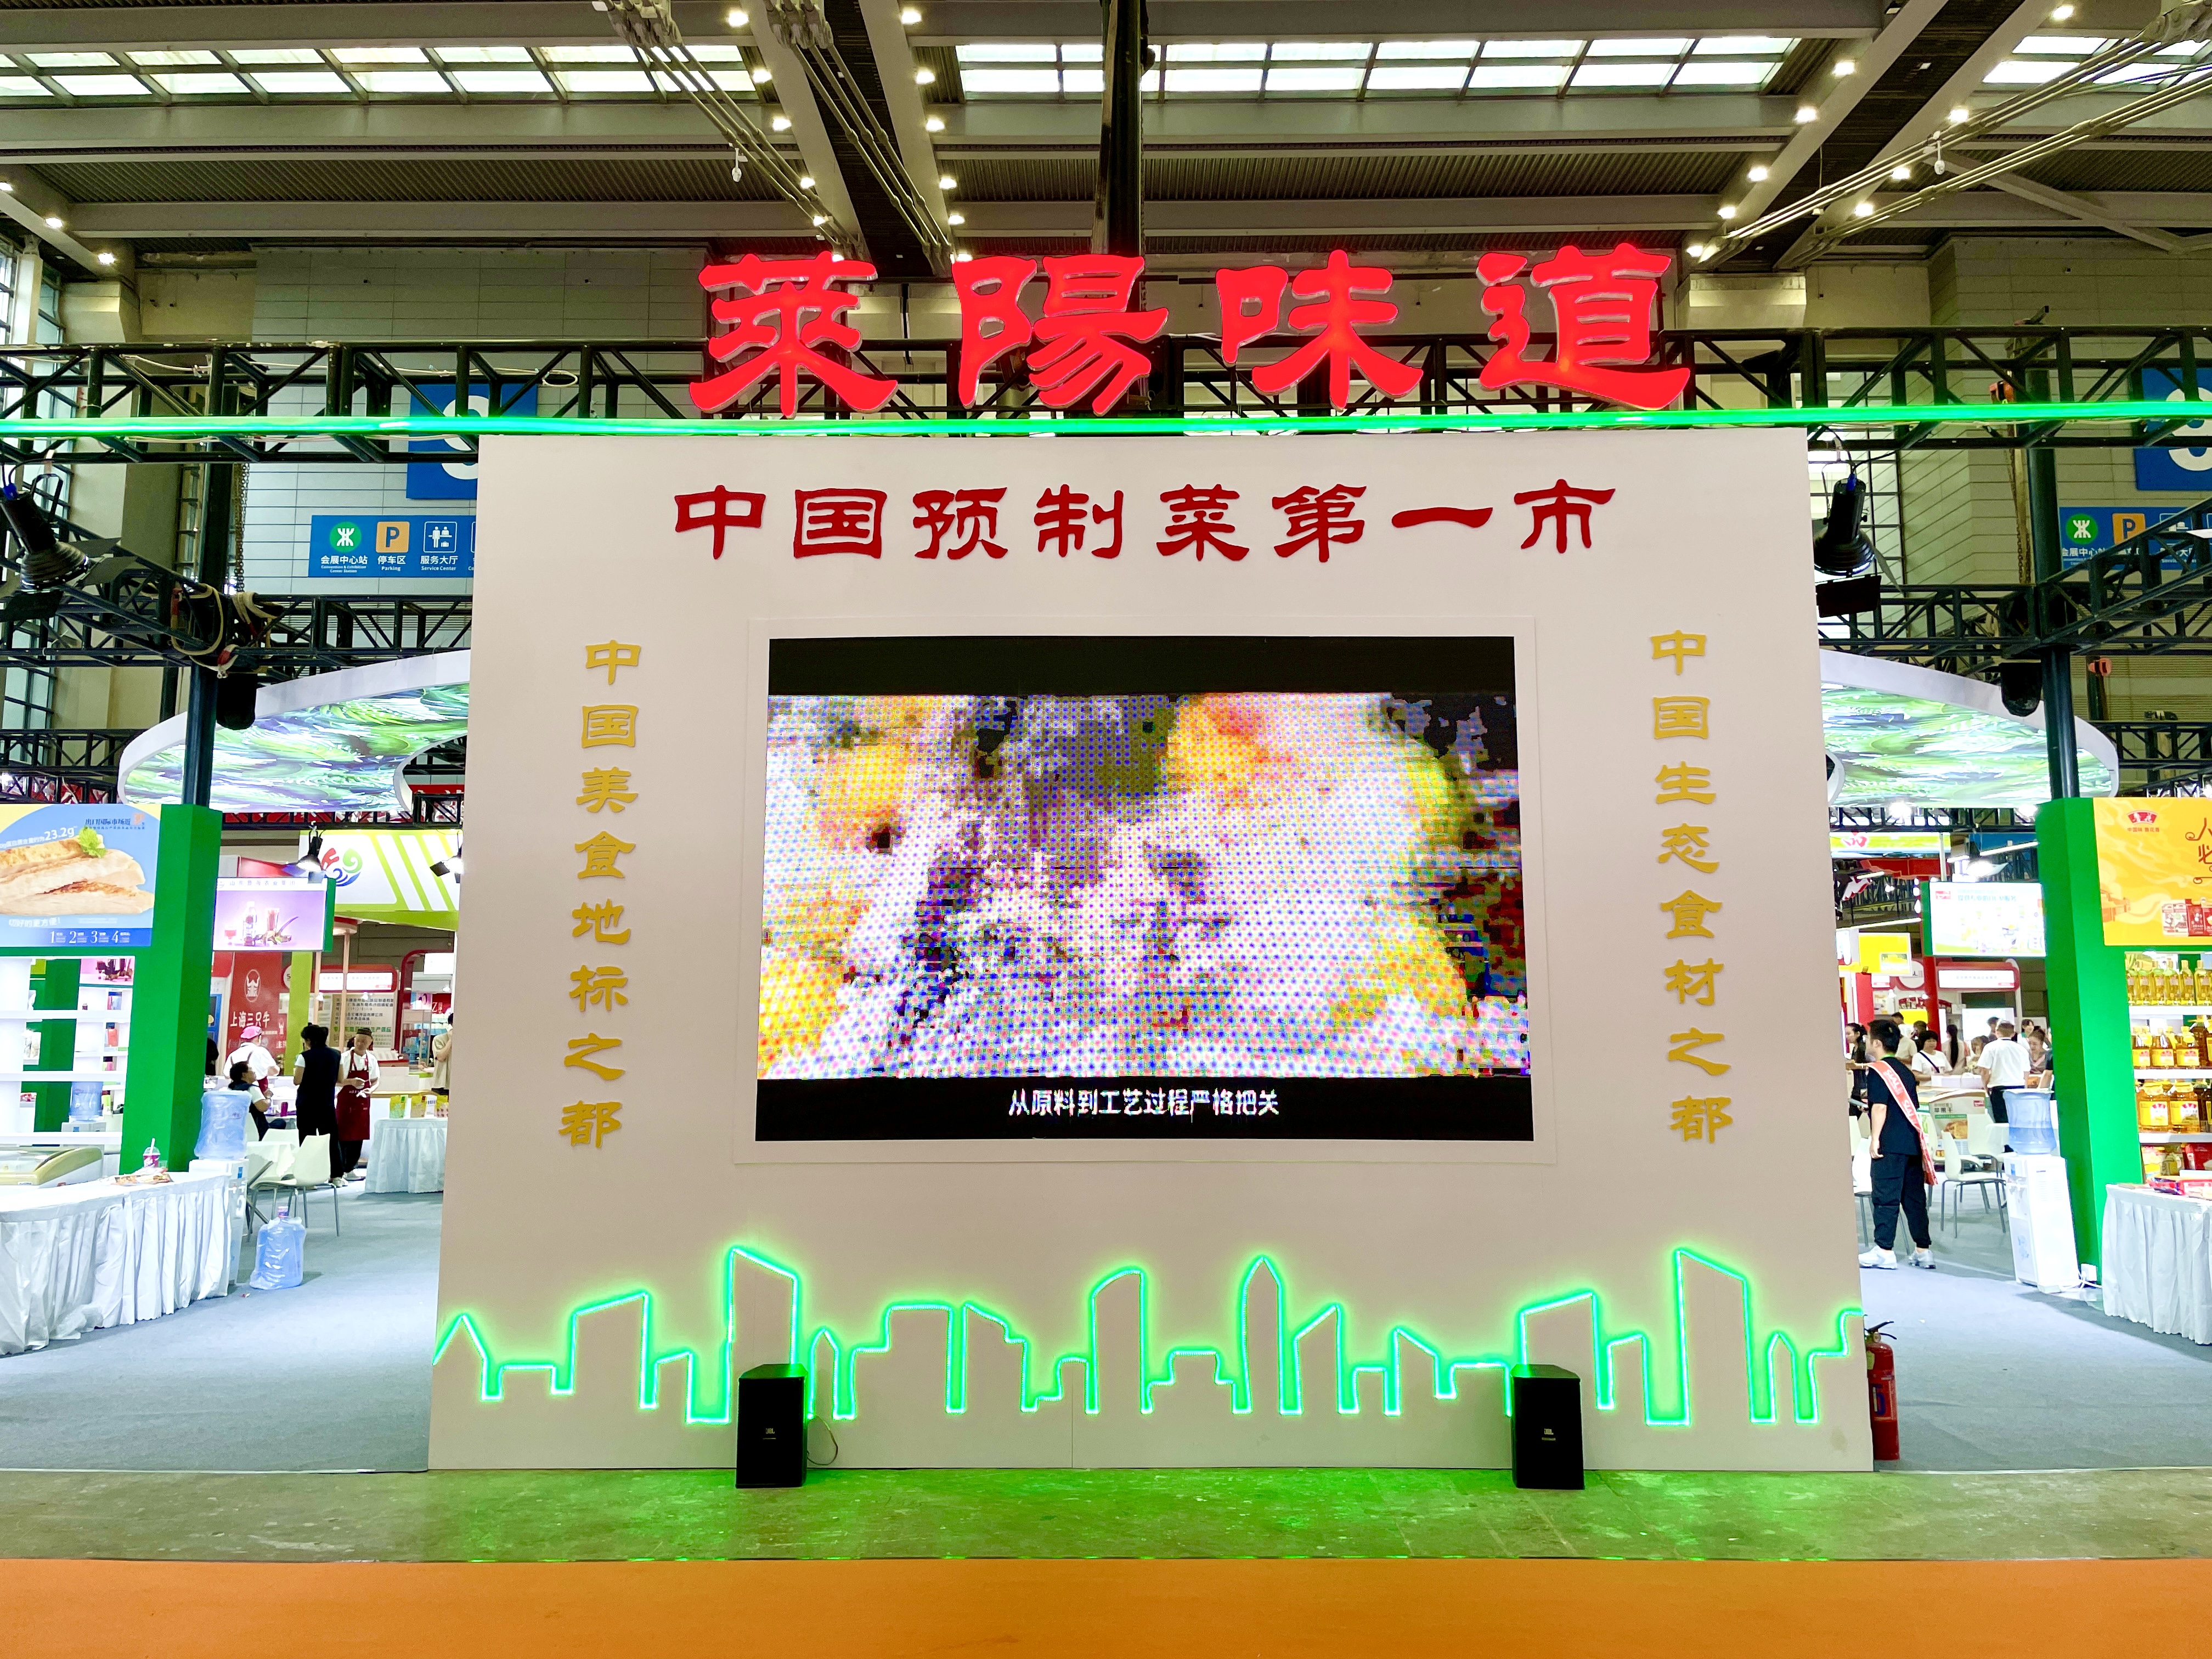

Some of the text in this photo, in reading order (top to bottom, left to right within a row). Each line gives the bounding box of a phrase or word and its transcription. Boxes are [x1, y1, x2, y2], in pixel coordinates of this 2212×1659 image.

[689, 242, 1690, 417] 萊陽味道
[675, 479, 1616, 563] 中国预制菜第一市
[320, 555, 368, 565] 会展中心站
[377, 555, 406, 565] 停车区
[420, 555, 458, 565] 服务大厅
[558, 640, 641, 1149] 中国美食地标之都
[1651, 630, 1734, 1144] 中国生态食材之都
[230, 1011, 270, 1028] 上海三只牛
[1009, 1087, 1279, 1116] 从原料到工艺过程严格把关
